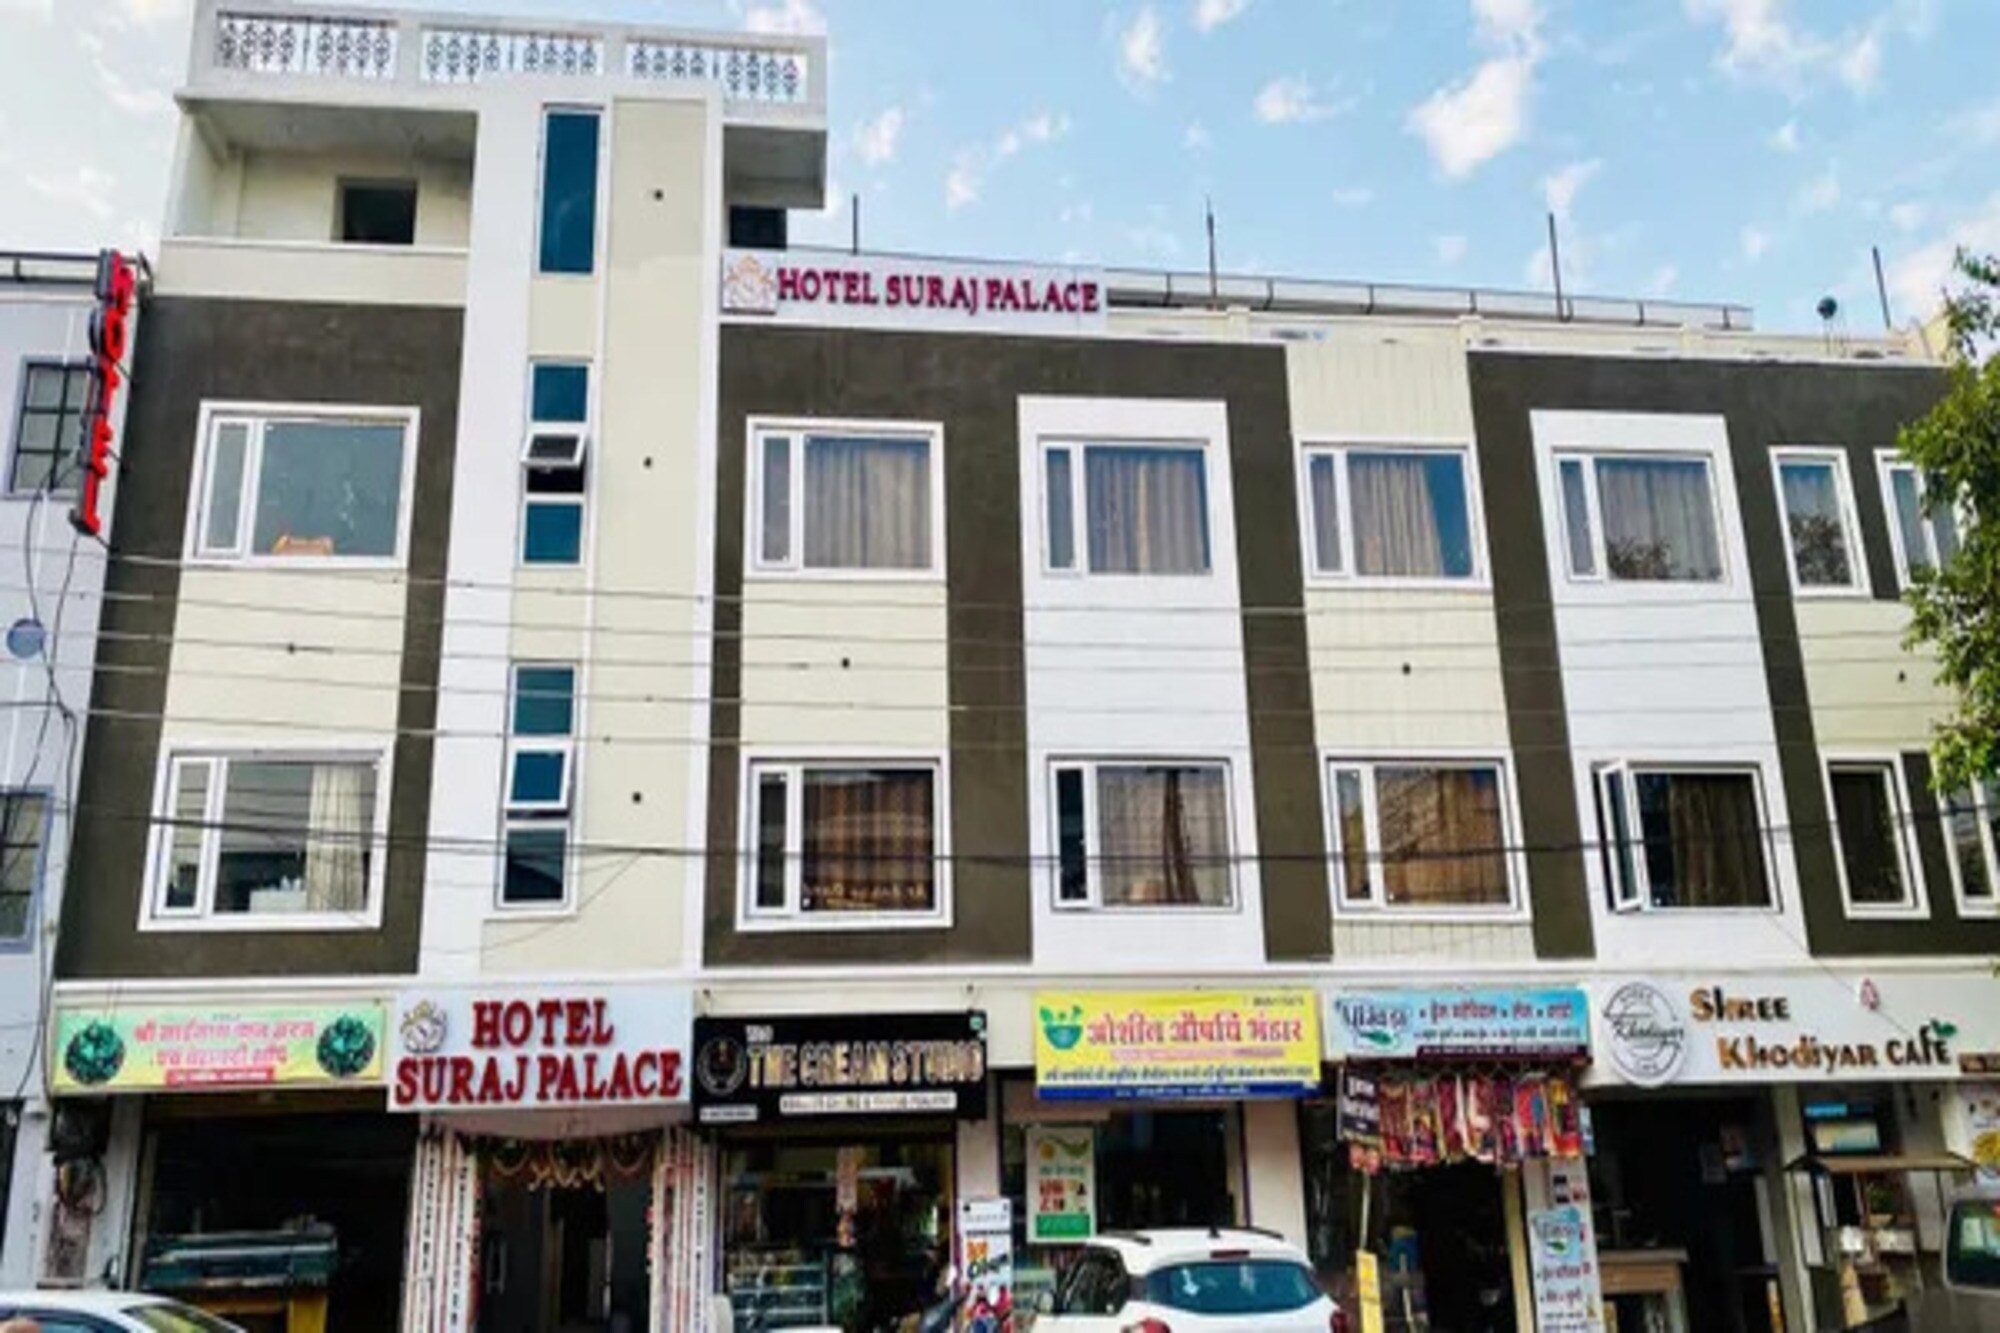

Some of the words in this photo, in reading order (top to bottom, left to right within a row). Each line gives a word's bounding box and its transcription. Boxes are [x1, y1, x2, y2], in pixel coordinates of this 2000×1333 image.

[777, 268, 879, 305] HOTEL
[886, 274, 979, 315] SURAJ
[987, 281, 1099, 312] PALACE
[471, 998, 614, 1048] HOTEL
[395, 1055, 529, 1105] SURAJ
[536, 1051, 683, 1101] PALACE
[748, 1044, 797, 1088] THE
[800, 1040, 889, 1086] CREAM
[892, 1039, 984, 1083] STUDIO
